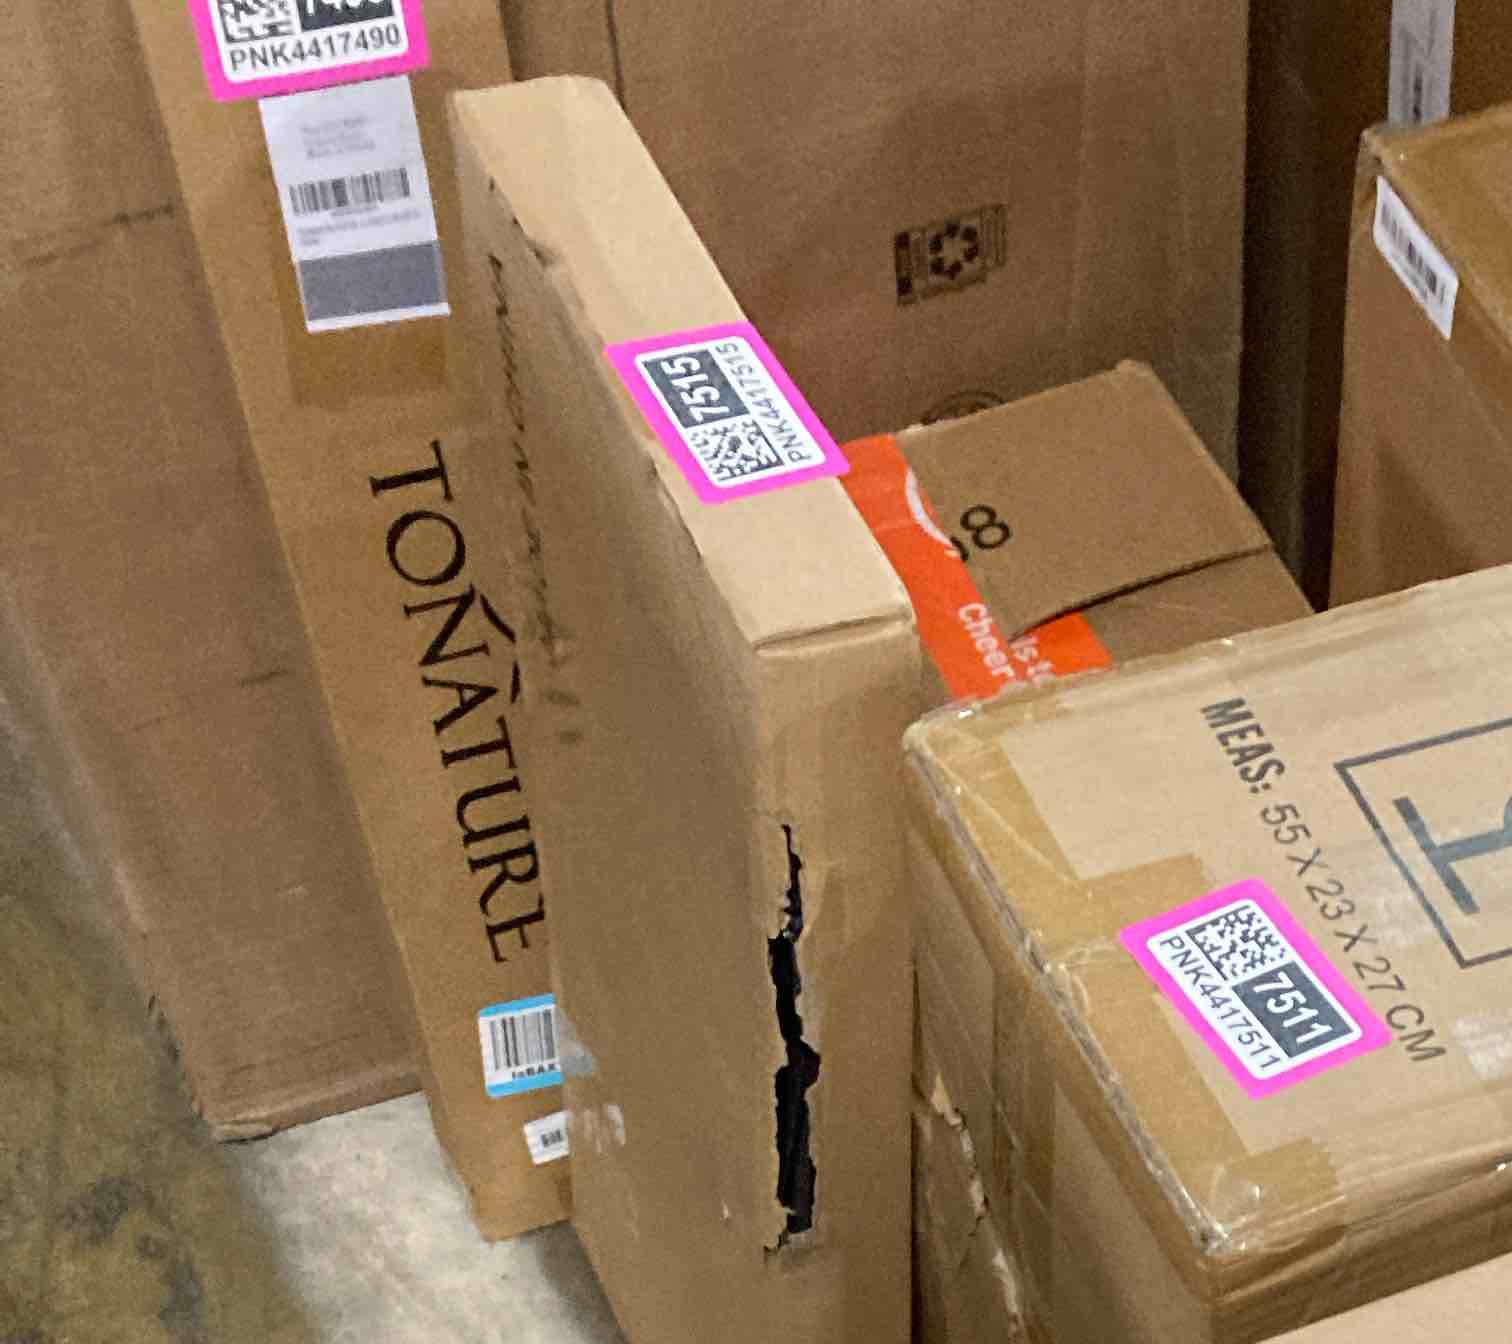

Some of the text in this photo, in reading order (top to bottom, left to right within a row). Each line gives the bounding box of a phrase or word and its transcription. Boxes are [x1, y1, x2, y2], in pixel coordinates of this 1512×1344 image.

[229, 23, 400, 71] PNK4417490
[660, 356, 729, 424] 7515
[715, 342, 812, 463] PNK4417515
[1200, 698, 1286, 795] MEAS:
[1260, 802, 1313, 847] 55
[1304, 878, 1357, 922] 23
[1352, 955, 1406, 998] 27
[1385, 1002, 1447, 1063] CM
[1158, 933, 1282, 1071] PNK4417511
[1250, 971, 1336, 1045] 7511
